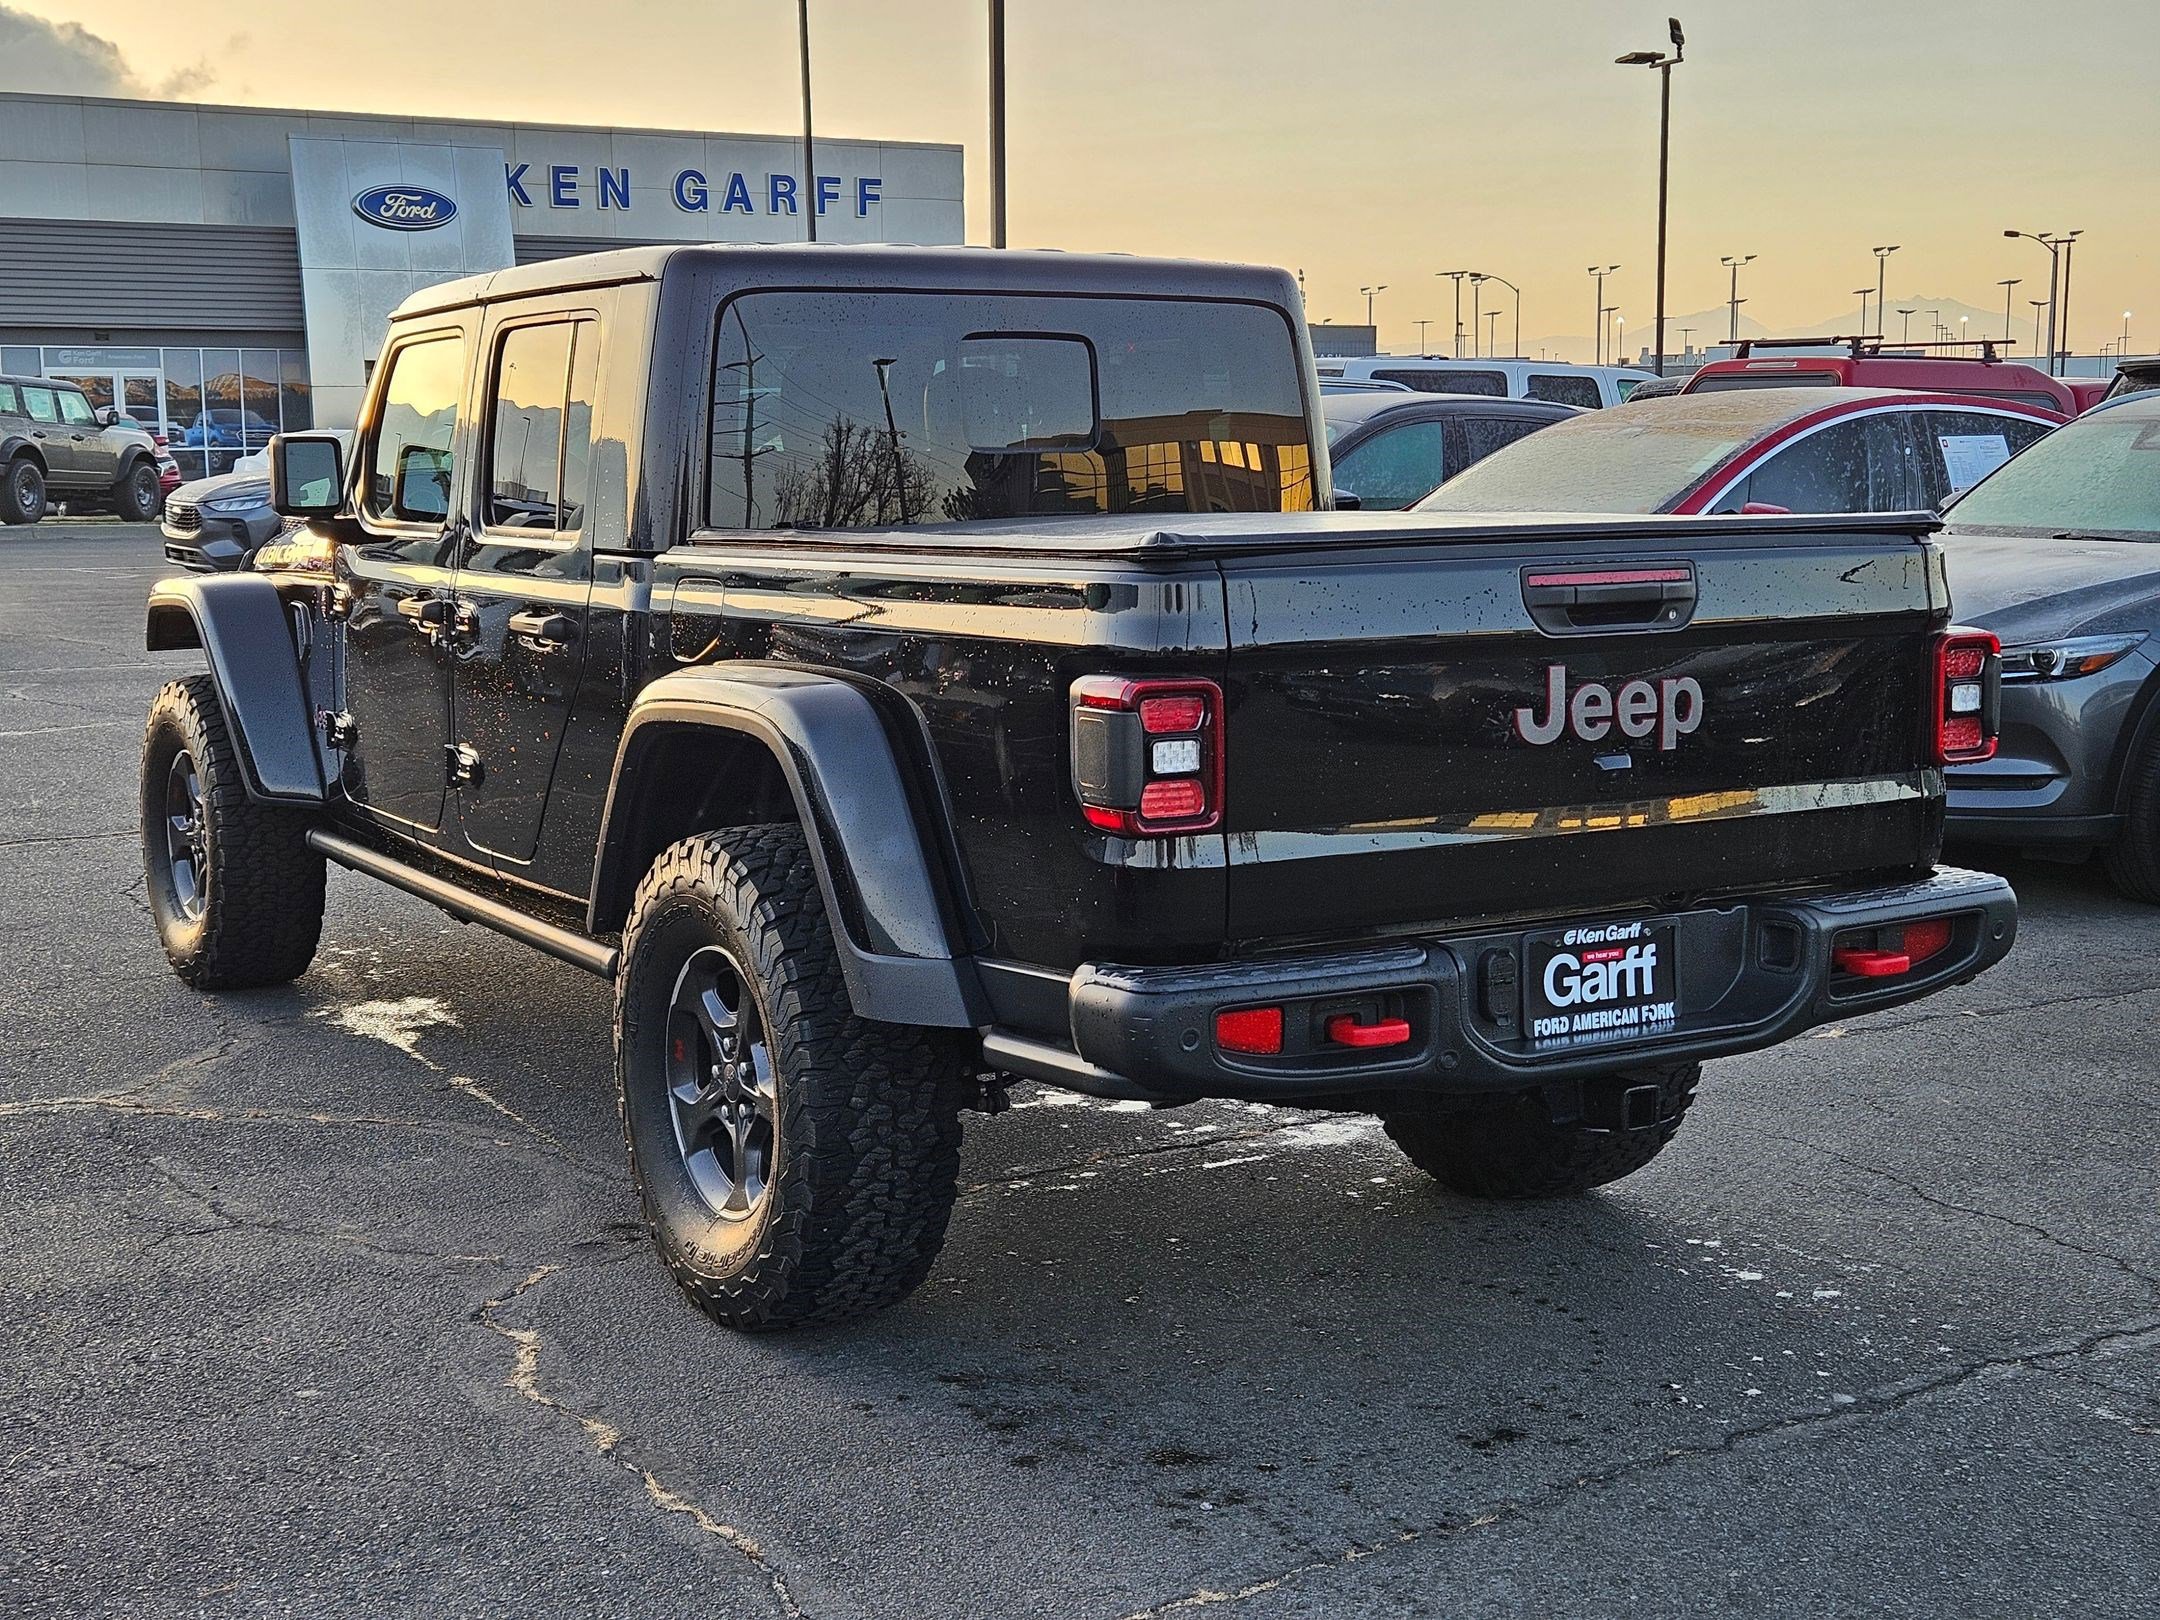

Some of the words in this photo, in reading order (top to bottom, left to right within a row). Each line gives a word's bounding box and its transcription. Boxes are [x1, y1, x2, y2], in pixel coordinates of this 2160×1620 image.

[380, 193, 437, 219] Ford
[504, 163, 631, 209] KEN
[674, 168, 883, 218] GARFF
[1512, 664, 1704, 752] Jeep
[1576, 927, 1605, 945] Ken
[1605, 923, 1642, 941] Garff
[1543, 943, 1657, 1008] Garff
[1534, 1016, 1569, 1037] FORD
[1572, 1007, 1639, 1032] AMERICAN
[1641, 1002, 1676, 1022] FORK
